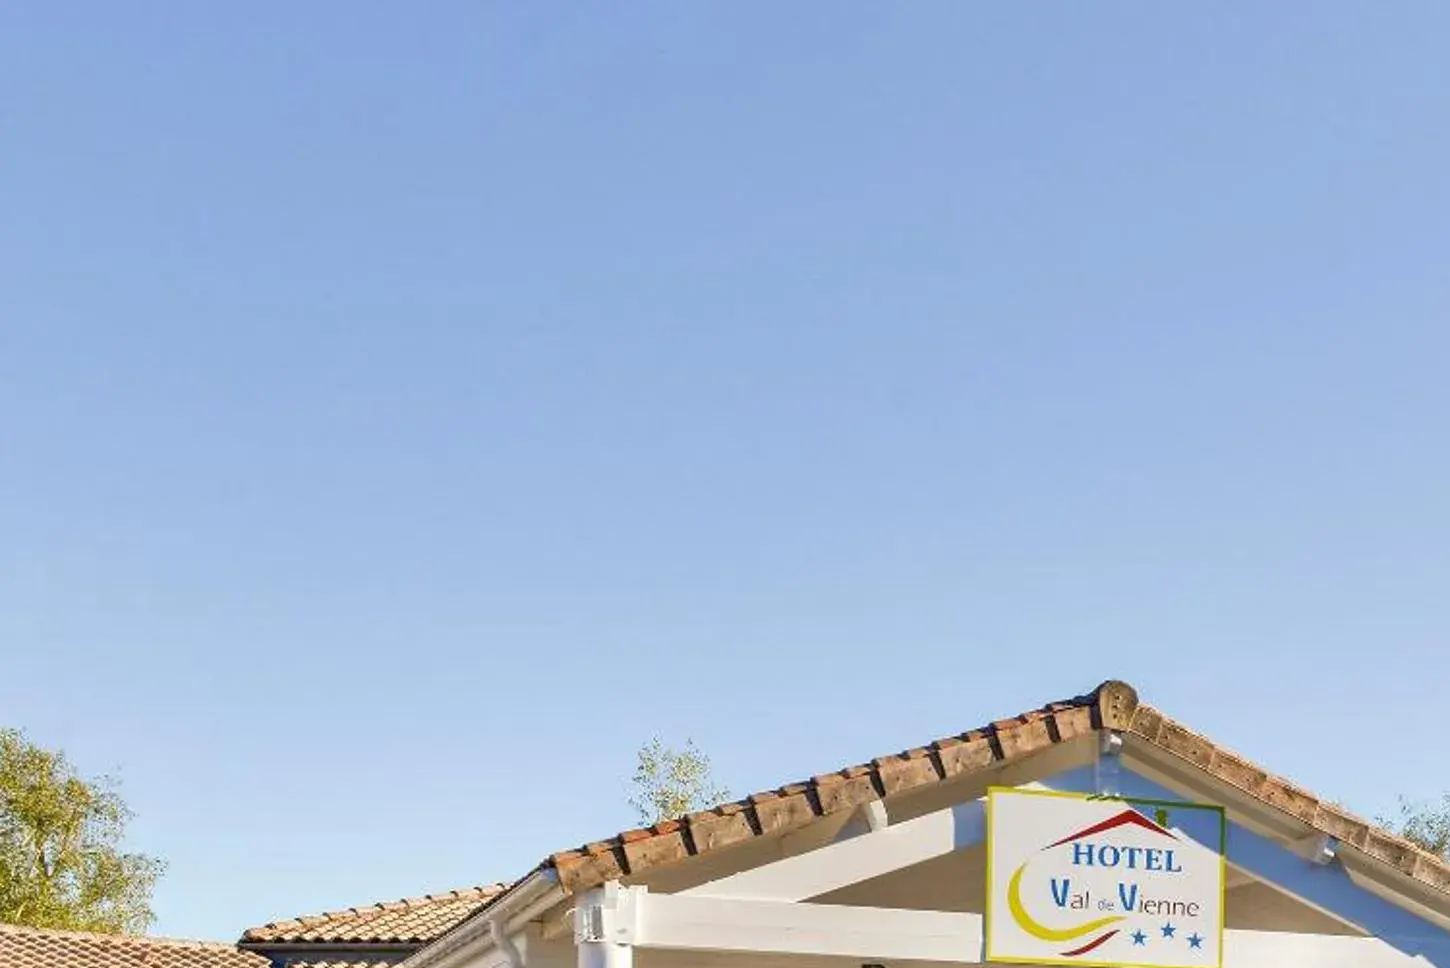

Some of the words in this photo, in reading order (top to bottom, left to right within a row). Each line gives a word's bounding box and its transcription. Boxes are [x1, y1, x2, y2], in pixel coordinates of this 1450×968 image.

[1072, 842, 1182, 873] HOTEL
[1051, 878, 1090, 910] Val
[1097, 899, 1114, 911] de
[1118, 882, 1200, 917] Vienne
